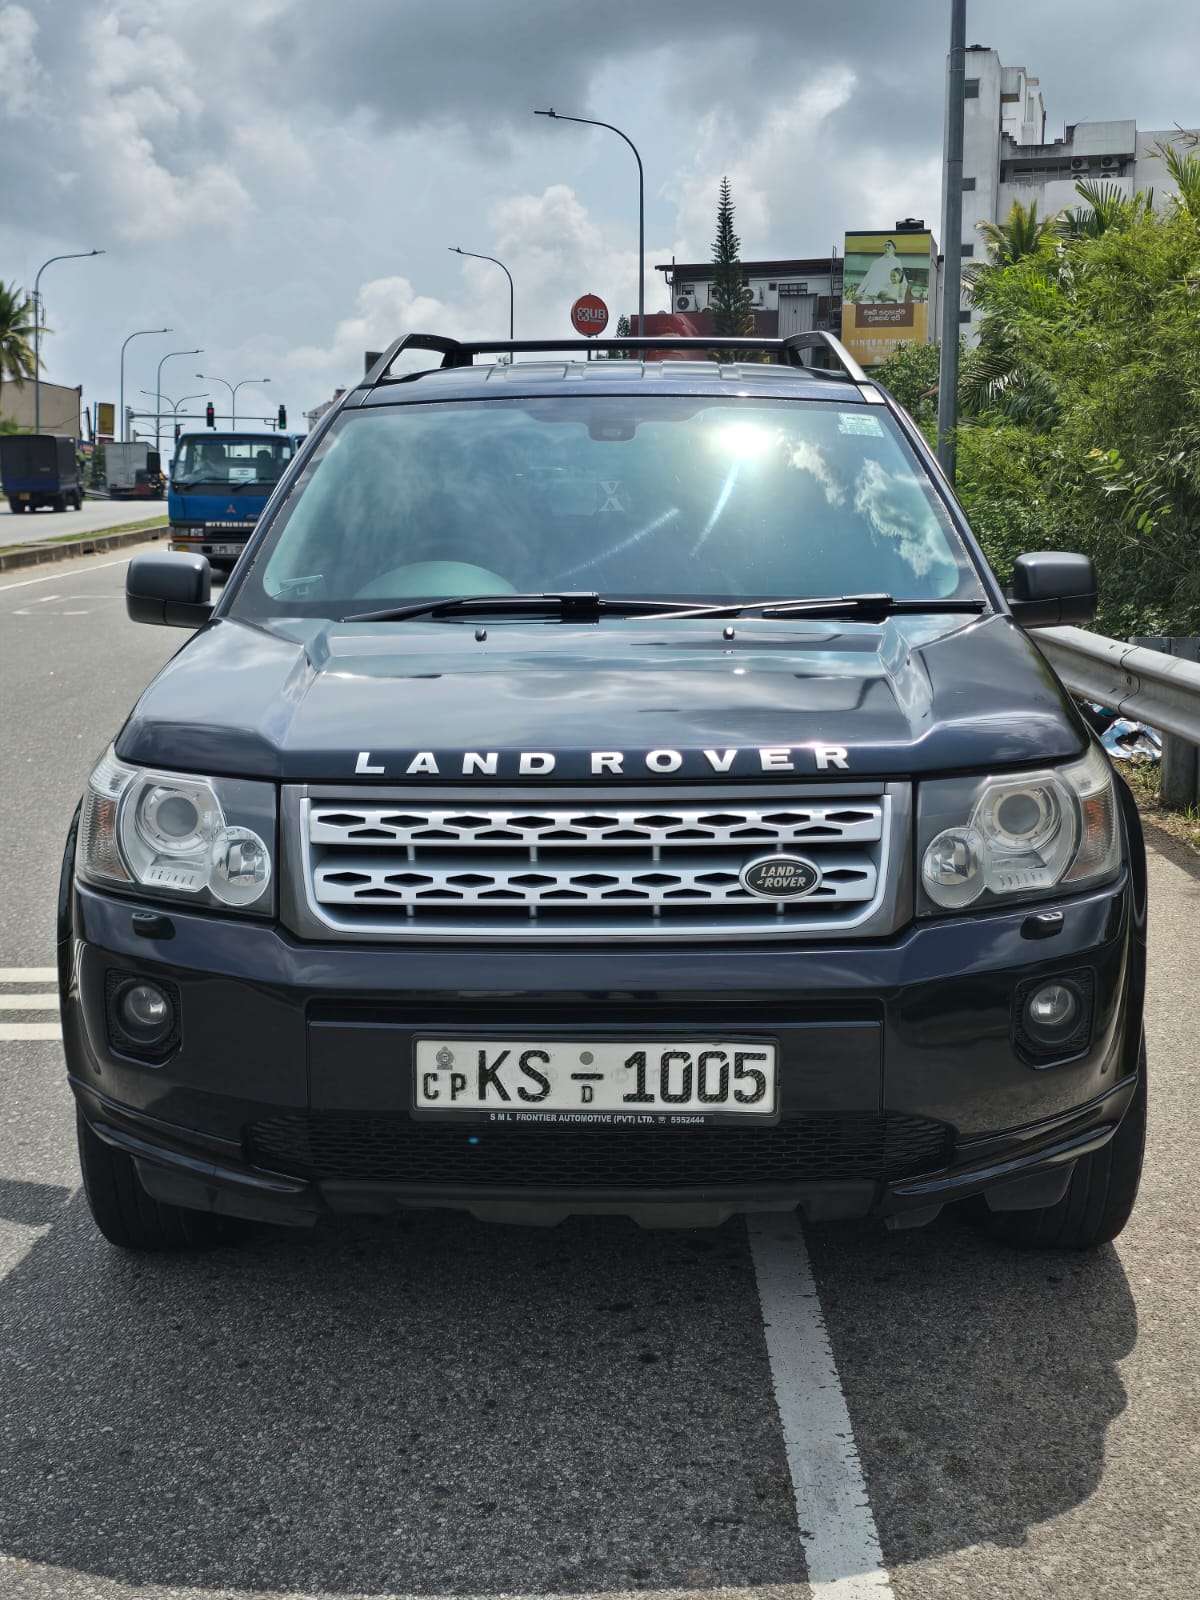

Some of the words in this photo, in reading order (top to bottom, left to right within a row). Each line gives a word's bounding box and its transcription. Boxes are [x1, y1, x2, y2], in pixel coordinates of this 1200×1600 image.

[355, 750, 556, 775] LAND
[591, 746, 851, 775] ROVER
[764, 876, 807, 888] ROVER
[622, 1051, 767, 1104] 1005
[516, 1113, 557, 1122] FRONTIER
[558, 1114, 612, 1123] AUTOMOTIVE
[613, 1115, 636, 1124] (PVT)
[637, 1115, 655, 1124] LTD.
[670, 1116, 705, 1124] 5552444
